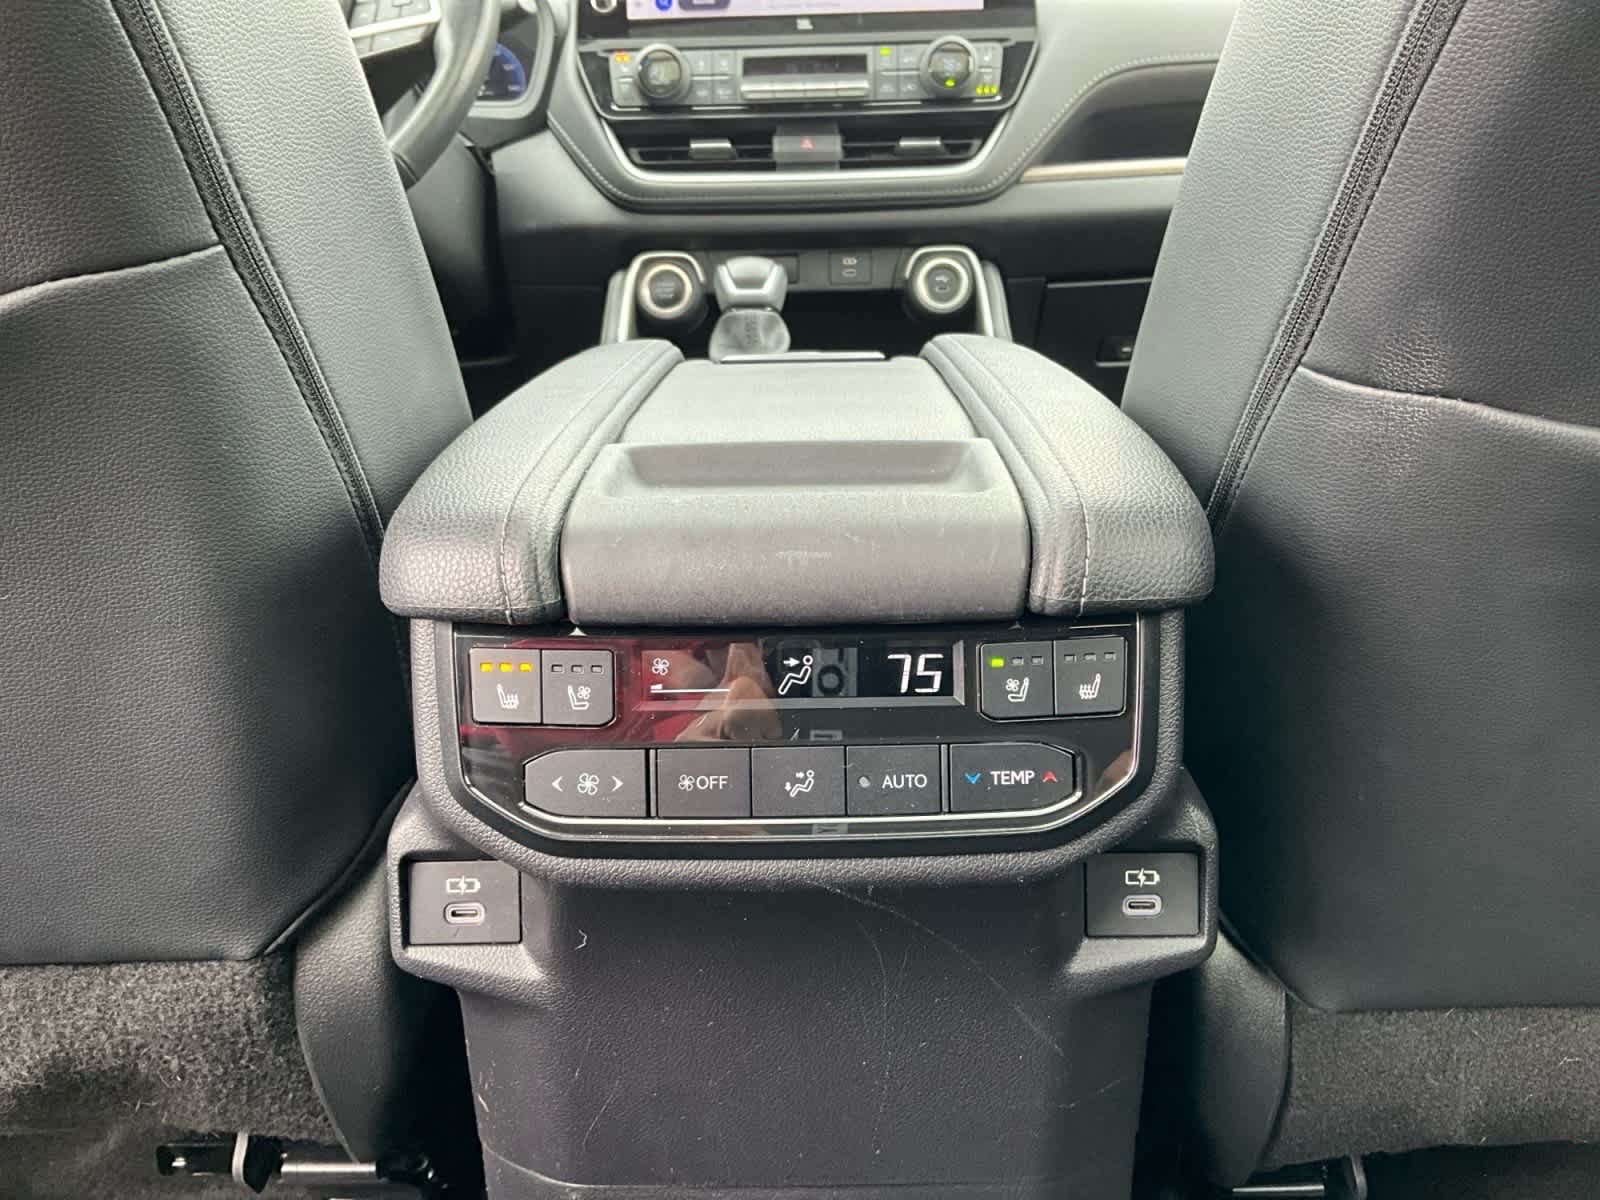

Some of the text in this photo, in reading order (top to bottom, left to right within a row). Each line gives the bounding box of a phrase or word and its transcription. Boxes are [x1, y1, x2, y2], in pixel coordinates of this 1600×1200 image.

[887, 653, 944, 693] 75
[696, 775, 729, 790] OFF
[882, 774, 928, 789] AUTO
[990, 770, 1035, 785] TEMP
